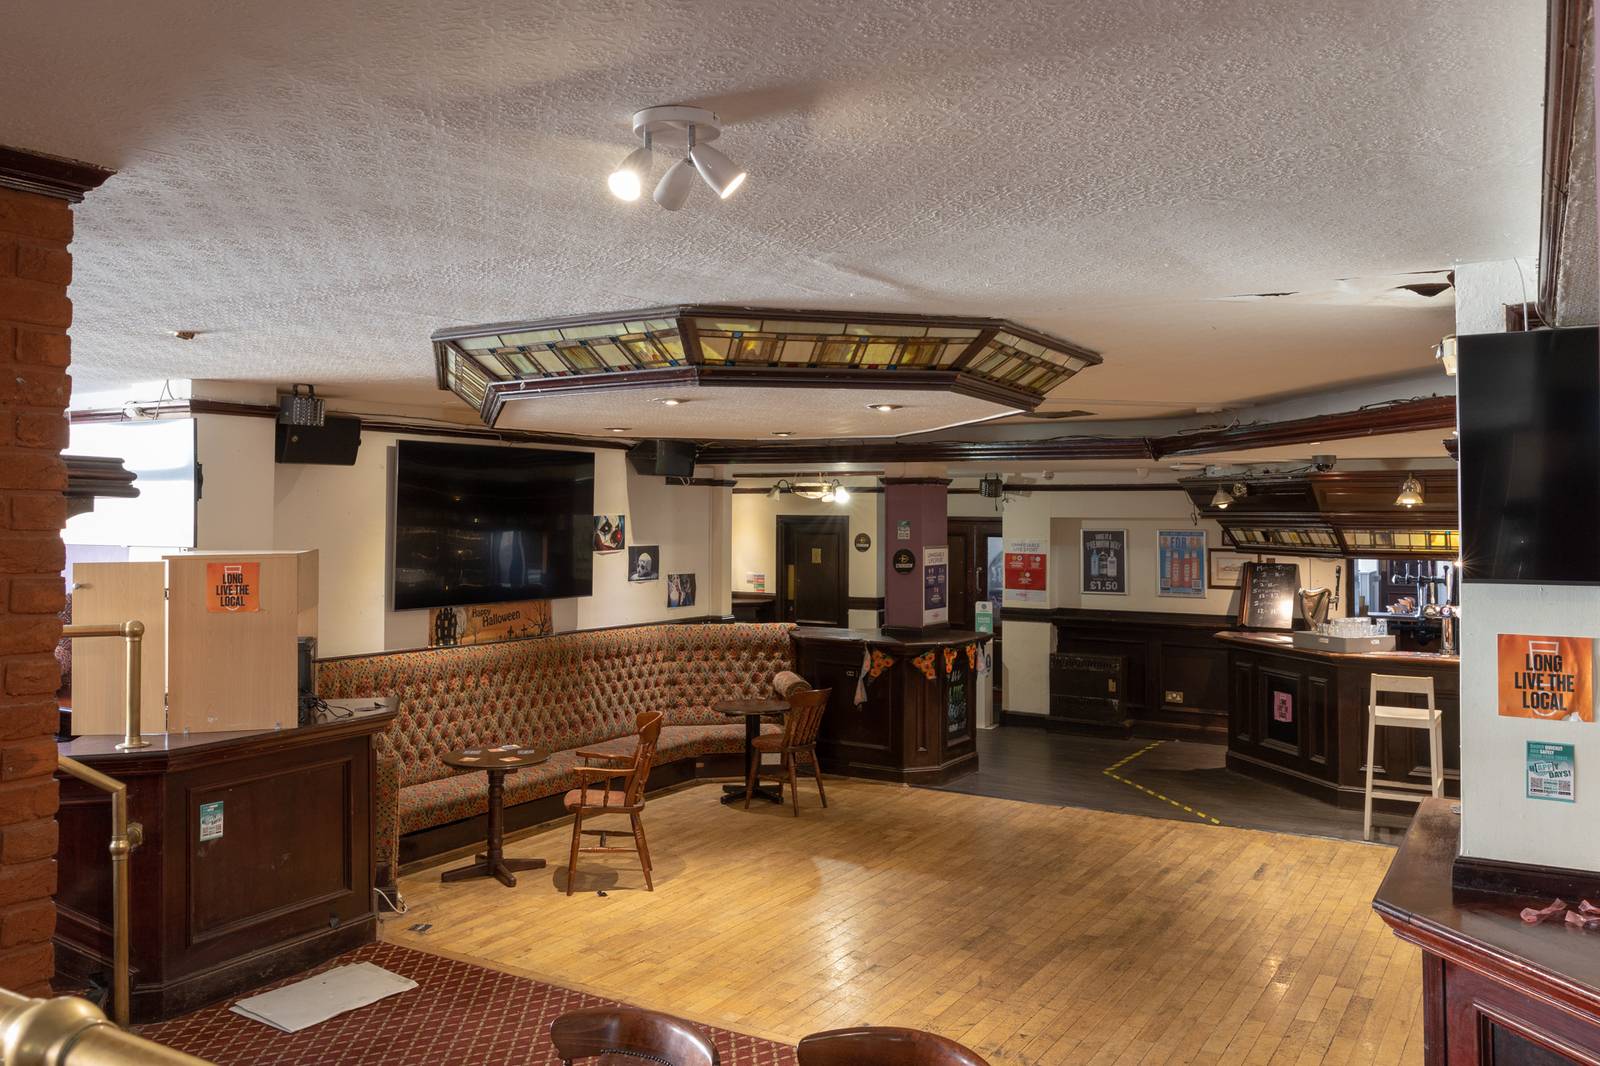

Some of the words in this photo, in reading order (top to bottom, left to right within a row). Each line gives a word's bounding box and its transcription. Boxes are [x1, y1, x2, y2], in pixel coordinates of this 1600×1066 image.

[222, 573, 244, 584] LONG
[216, 585, 233, 596] LIVE
[235, 585, 250, 595] THE
[1090, 581, 1118, 590] £1.50
[220, 596, 245, 607] LOCAL
[472, 608, 491, 618] Happy
[482, 610, 521, 627] Halloween
[1526, 653, 1563, 673] LONG
[1514, 671, 1545, 691] LIVE
[1549, 674, 1574, 692] THE
[1522, 690, 1567, 711] LOCAL
[1549, 770, 1571, 778] DAYS!
